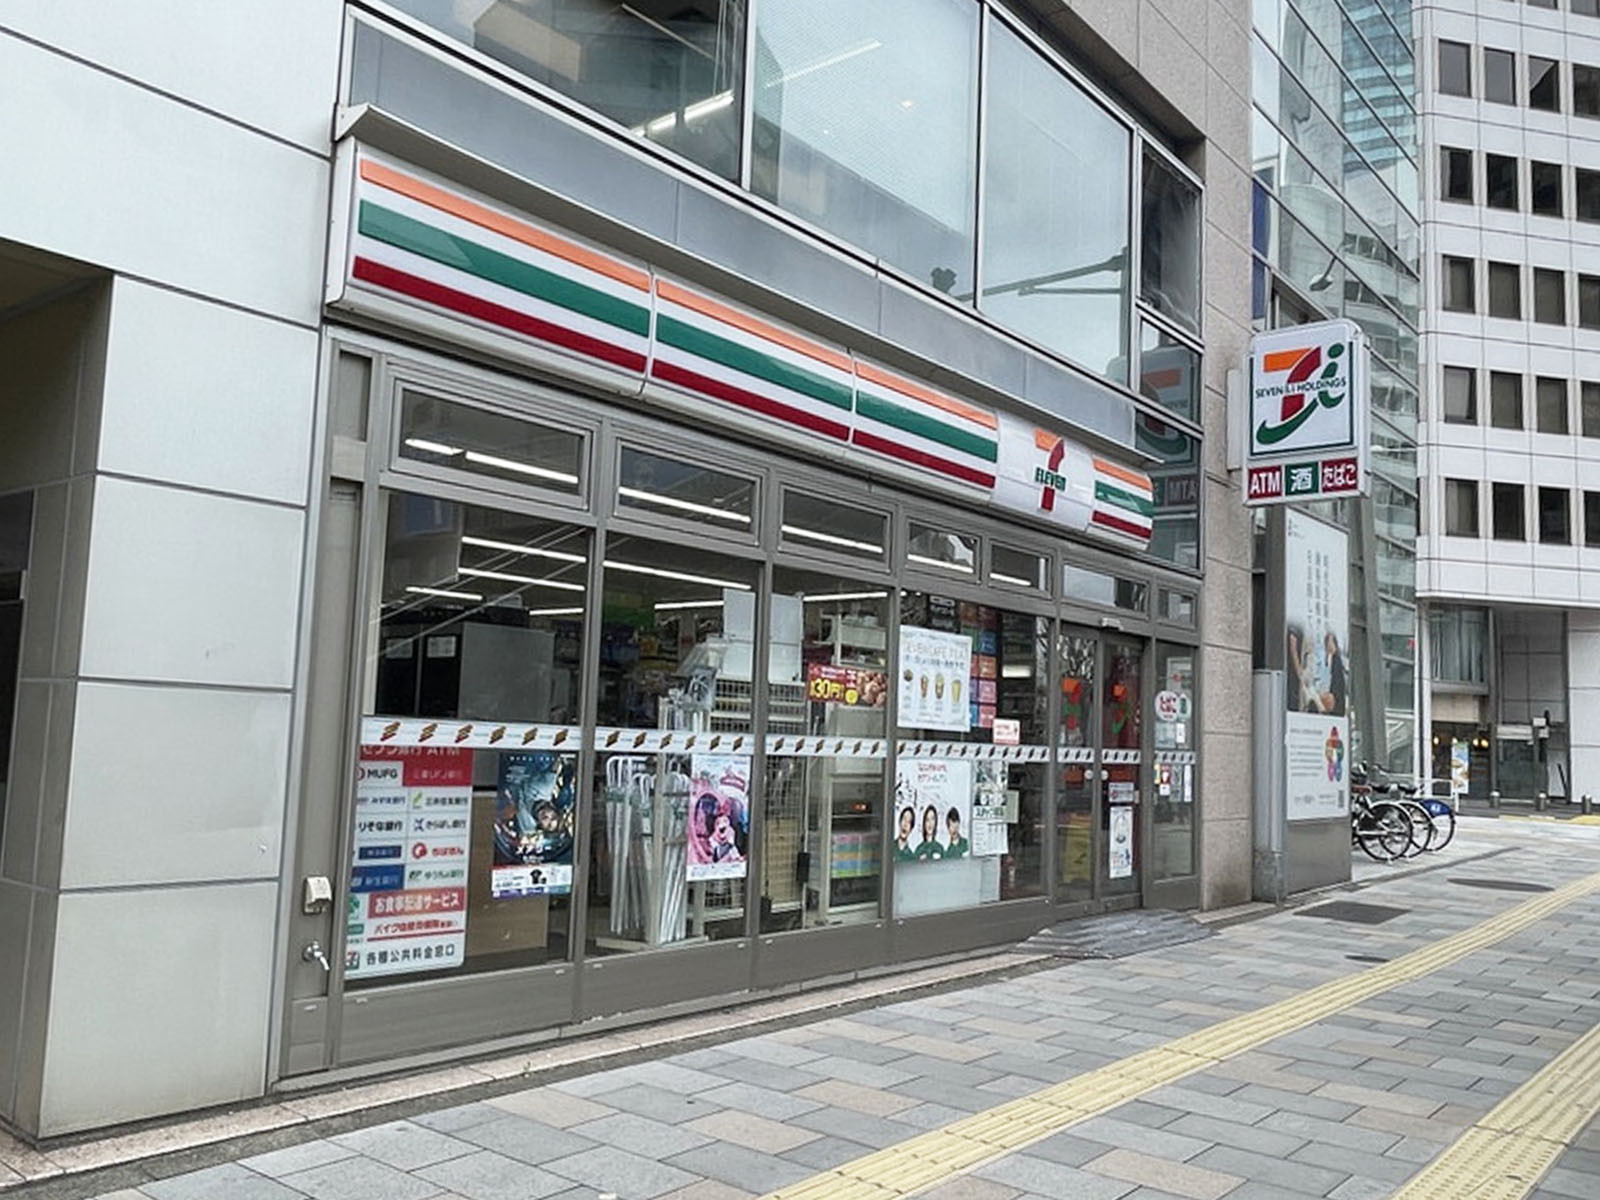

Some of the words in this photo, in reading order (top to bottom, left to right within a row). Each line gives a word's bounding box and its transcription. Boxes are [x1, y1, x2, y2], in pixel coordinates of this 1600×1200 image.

[1255, 384, 1284, 398] SEVEN
[1297, 376, 1347, 392] HOLDINGS
[1250, 469, 1281, 495] ATM
[1290, 466, 1313, 492] 酒
[1322, 462, 1357, 488] たばこ
[367, 767, 398, 779] MUFG
[366, 943, 455, 965] 各種公共料金窓口
